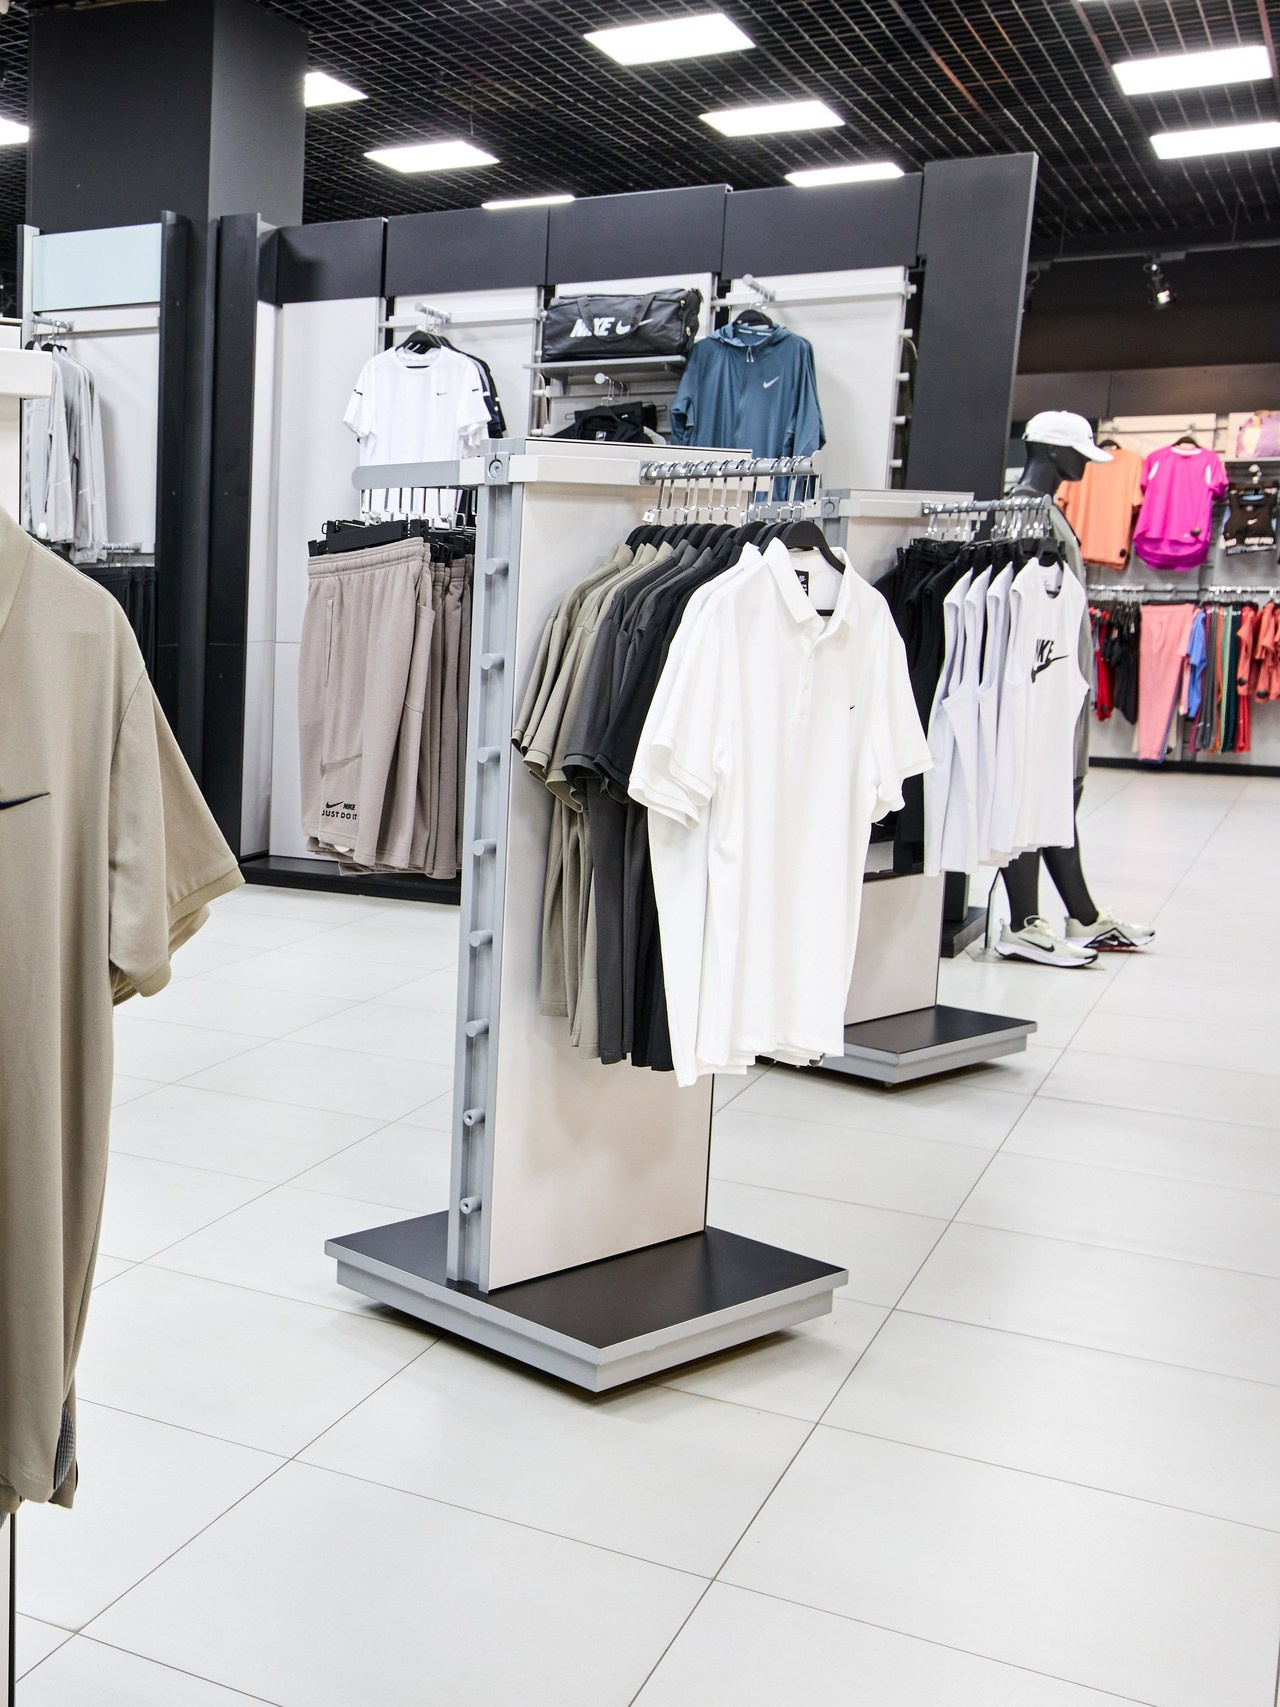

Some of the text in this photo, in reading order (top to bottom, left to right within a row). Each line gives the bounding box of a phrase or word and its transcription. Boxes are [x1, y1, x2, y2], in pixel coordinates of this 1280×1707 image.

[342, 803, 356, 811] NIKE
[321, 809, 340, 818] JUST
[340, 812, 352, 820] DO
